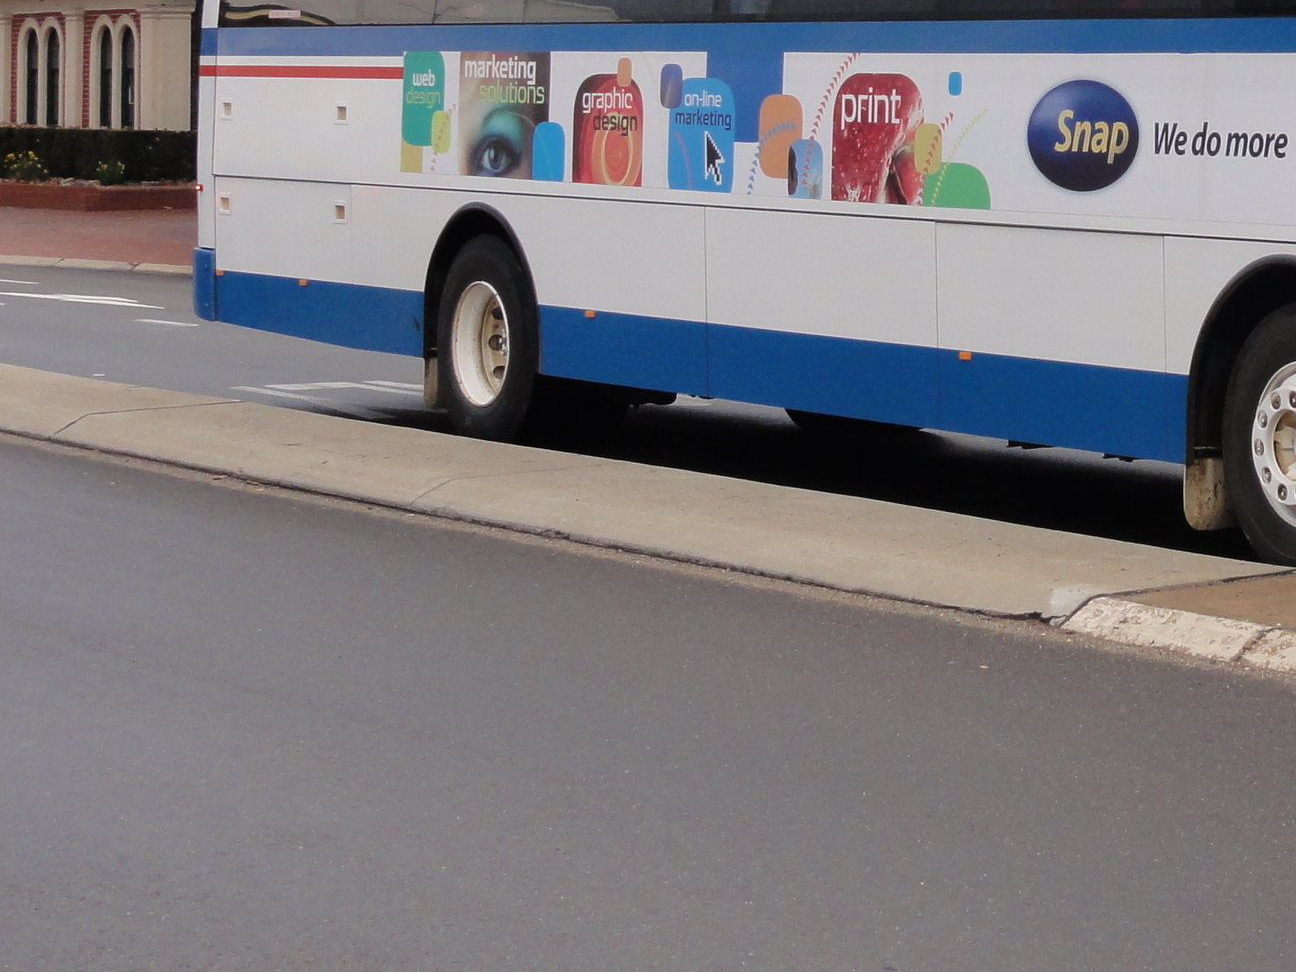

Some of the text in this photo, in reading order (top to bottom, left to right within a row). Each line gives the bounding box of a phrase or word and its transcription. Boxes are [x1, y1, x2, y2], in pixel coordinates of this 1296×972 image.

[412, 69, 436, 87] web
[463, 55, 537, 85] marketing
[405, 88, 441, 109] design
[478, 82, 545, 105] solutions
[582, 86, 633, 114] graphic
[684, 89, 722, 108] on-line
[674, 109, 732, 131] marketing
[841, 87, 902, 130] print
[592, 112, 638, 137] design
[1054, 108, 1129, 165] Snap
[1154, 122, 1289, 159] We do more
